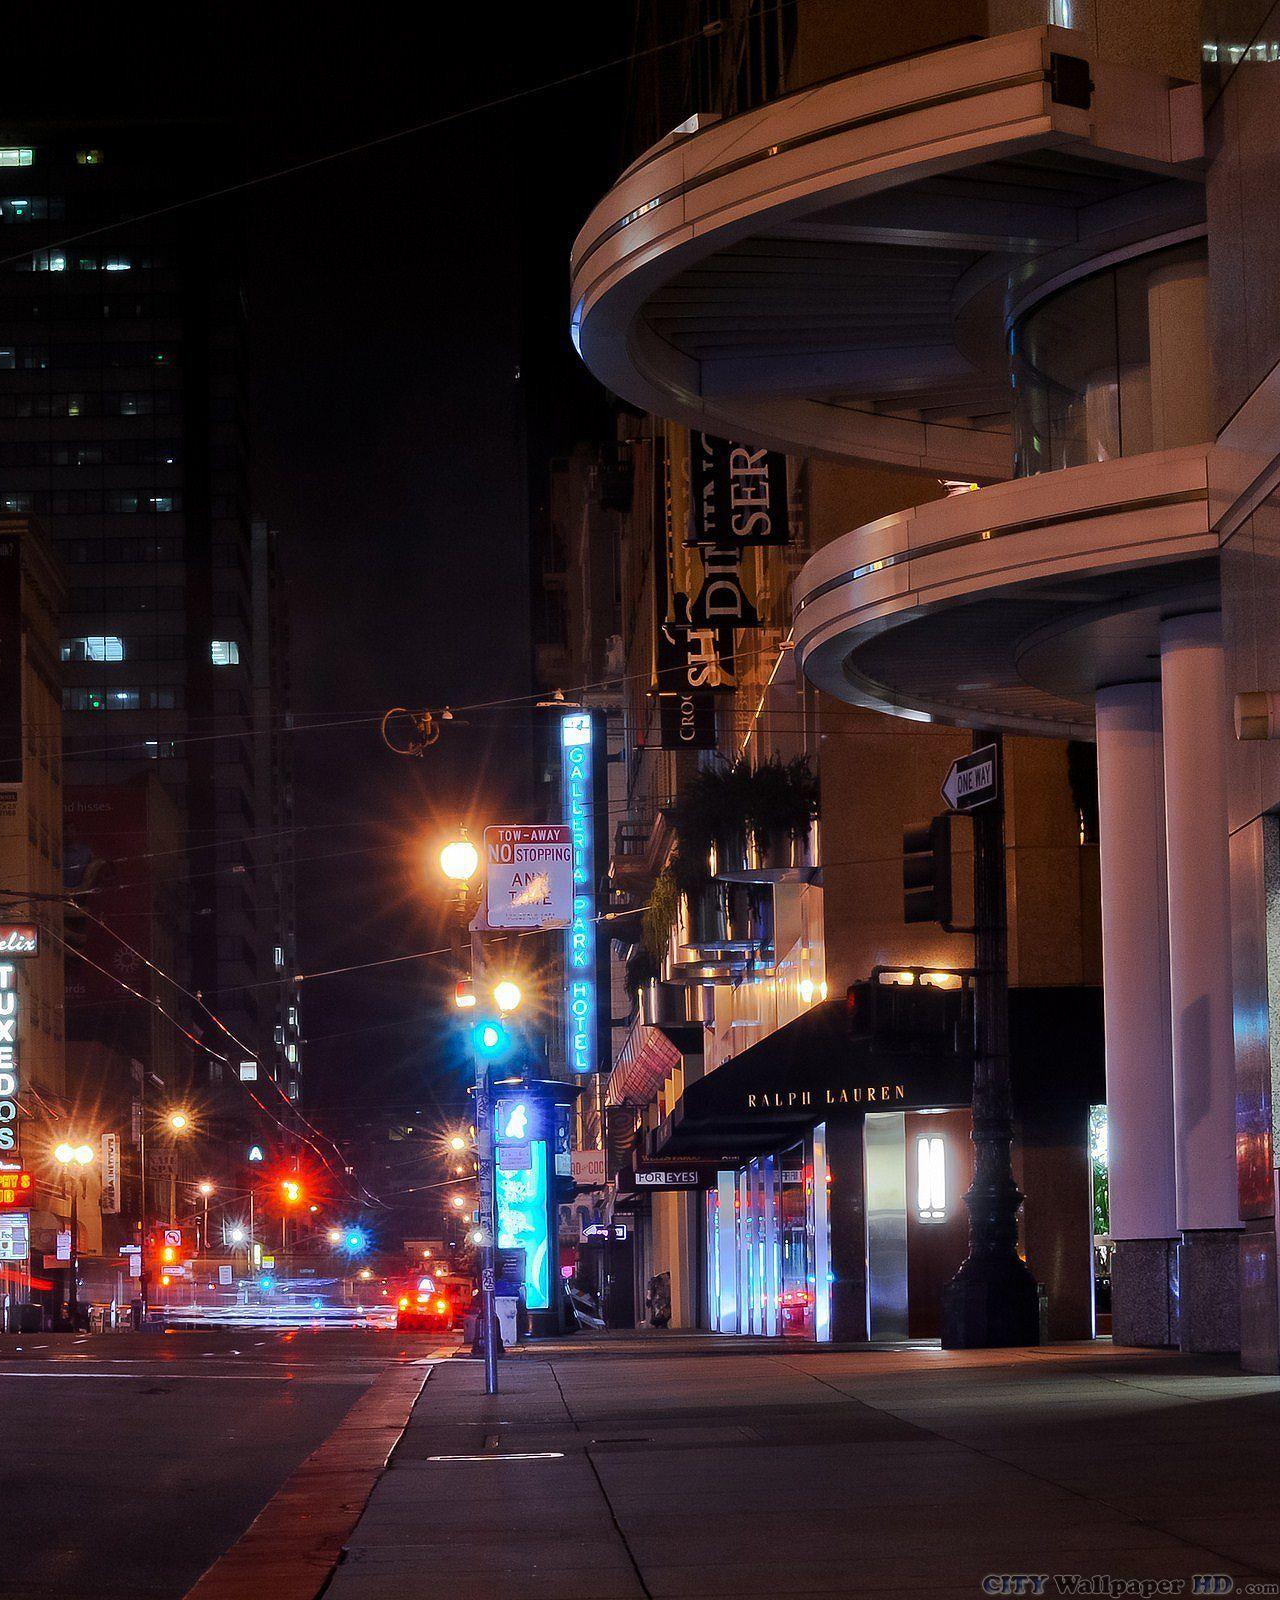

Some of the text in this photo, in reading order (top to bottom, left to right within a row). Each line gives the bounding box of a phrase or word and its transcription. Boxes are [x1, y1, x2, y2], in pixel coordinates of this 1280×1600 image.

[957, 764, 991, 794] ONE WAY
[569, 747, 587, 884] GALLERIA
[498, 830, 561, 842] TOW-AWAY
[488, 844, 571, 863] NO STOPPING
[508, 890, 553, 906] TE
[572, 895, 589, 967] PARK
[572, 982, 588, 1070] HOTEL
[748, 1084, 905, 1108] RALPH LAUREN
[640, 1171, 696, 1183] FOR EYES
